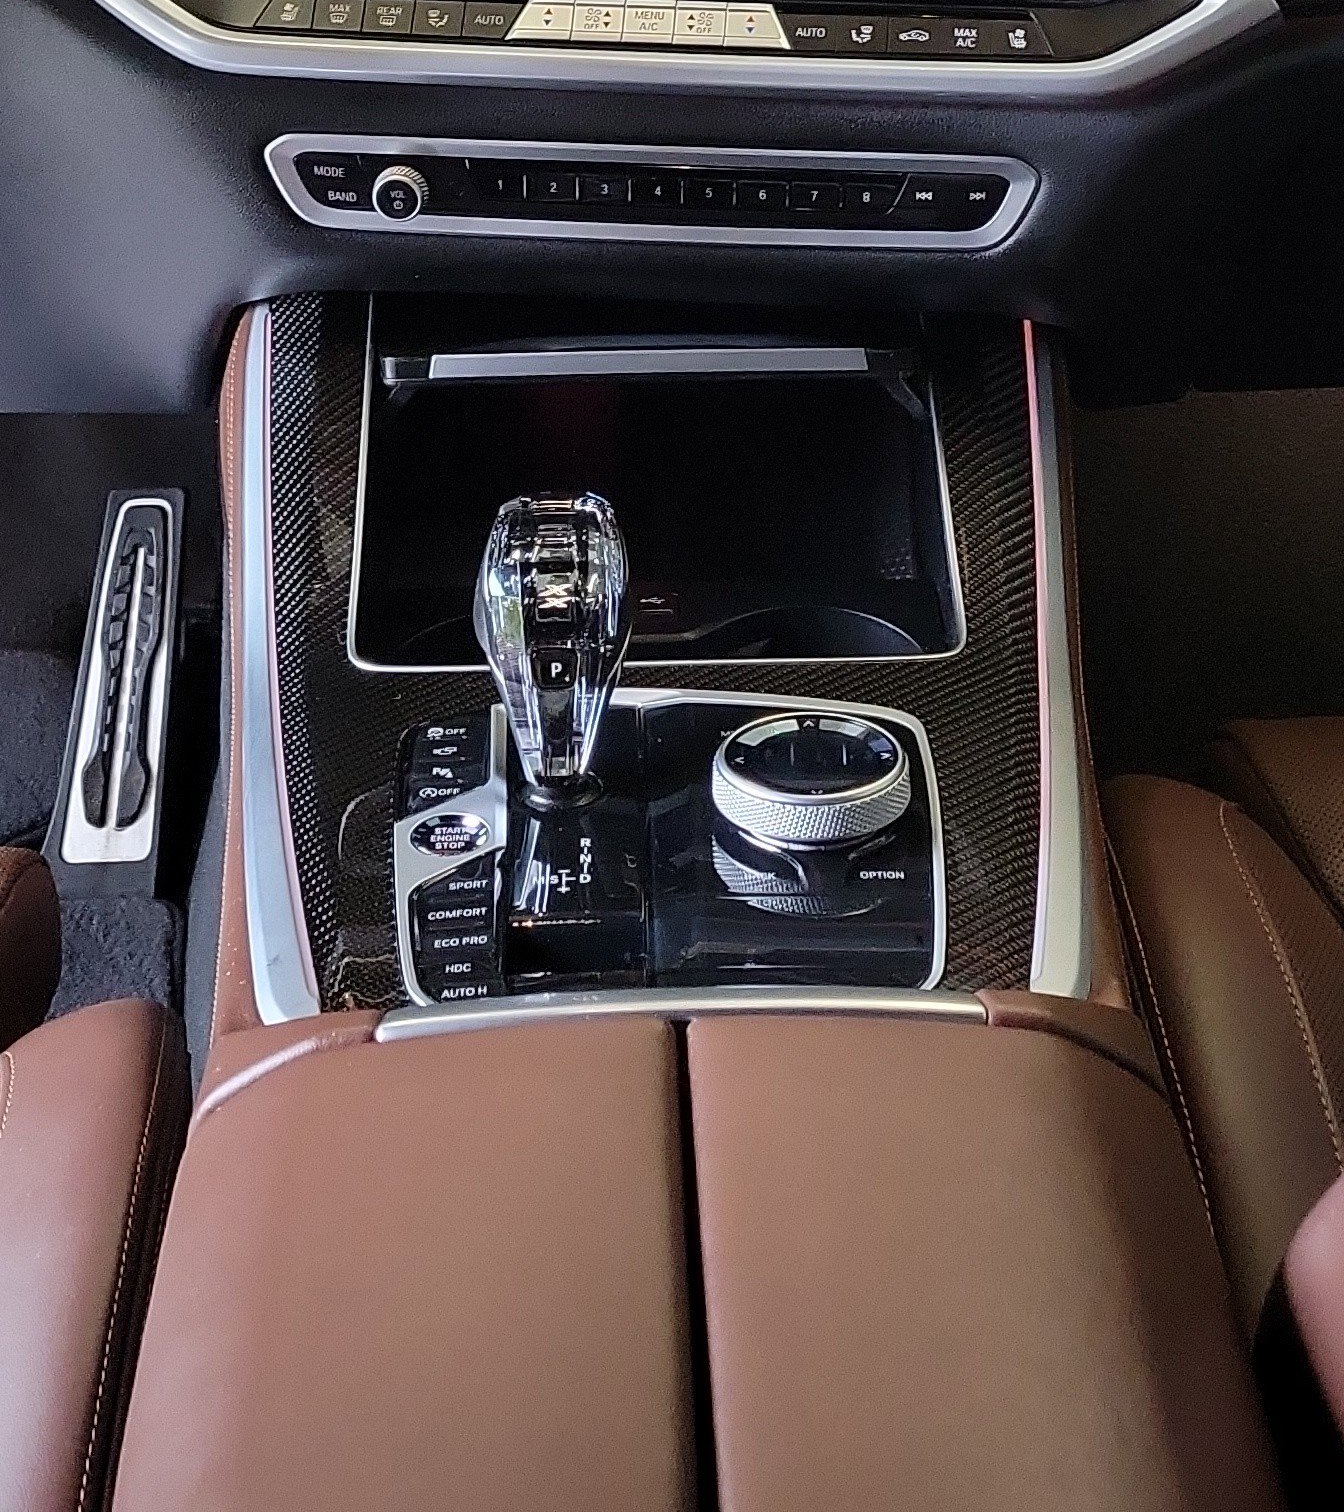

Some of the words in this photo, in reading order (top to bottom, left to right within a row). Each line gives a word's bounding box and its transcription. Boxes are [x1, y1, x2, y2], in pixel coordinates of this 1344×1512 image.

[328, 4, 352, 14] MAX
[376, 6, 403, 16] REAR
[473, 14, 505, 26] AUTO
[634, 10, 666, 21] MENU
[639, 21, 659, 31] A/C
[795, 26, 827, 38] AUTO
[954, 28, 978, 38] MAX
[955, 37, 977, 48] A/C
[314, 165, 346, 178] MODE
[328, 190, 356, 202] BAND
[551, 662, 562, 678] P
[438, 788, 460, 796] OFF
[859, 870, 905, 880] OPTION
[448, 879, 488, 890] SPORT
[427, 907, 488, 920] COMFORT
[434, 938, 460, 948] ECO
[462, 935, 488, 946] PRO
[444, 963, 472, 973] HDC
[440, 987, 476, 999] AUTO
